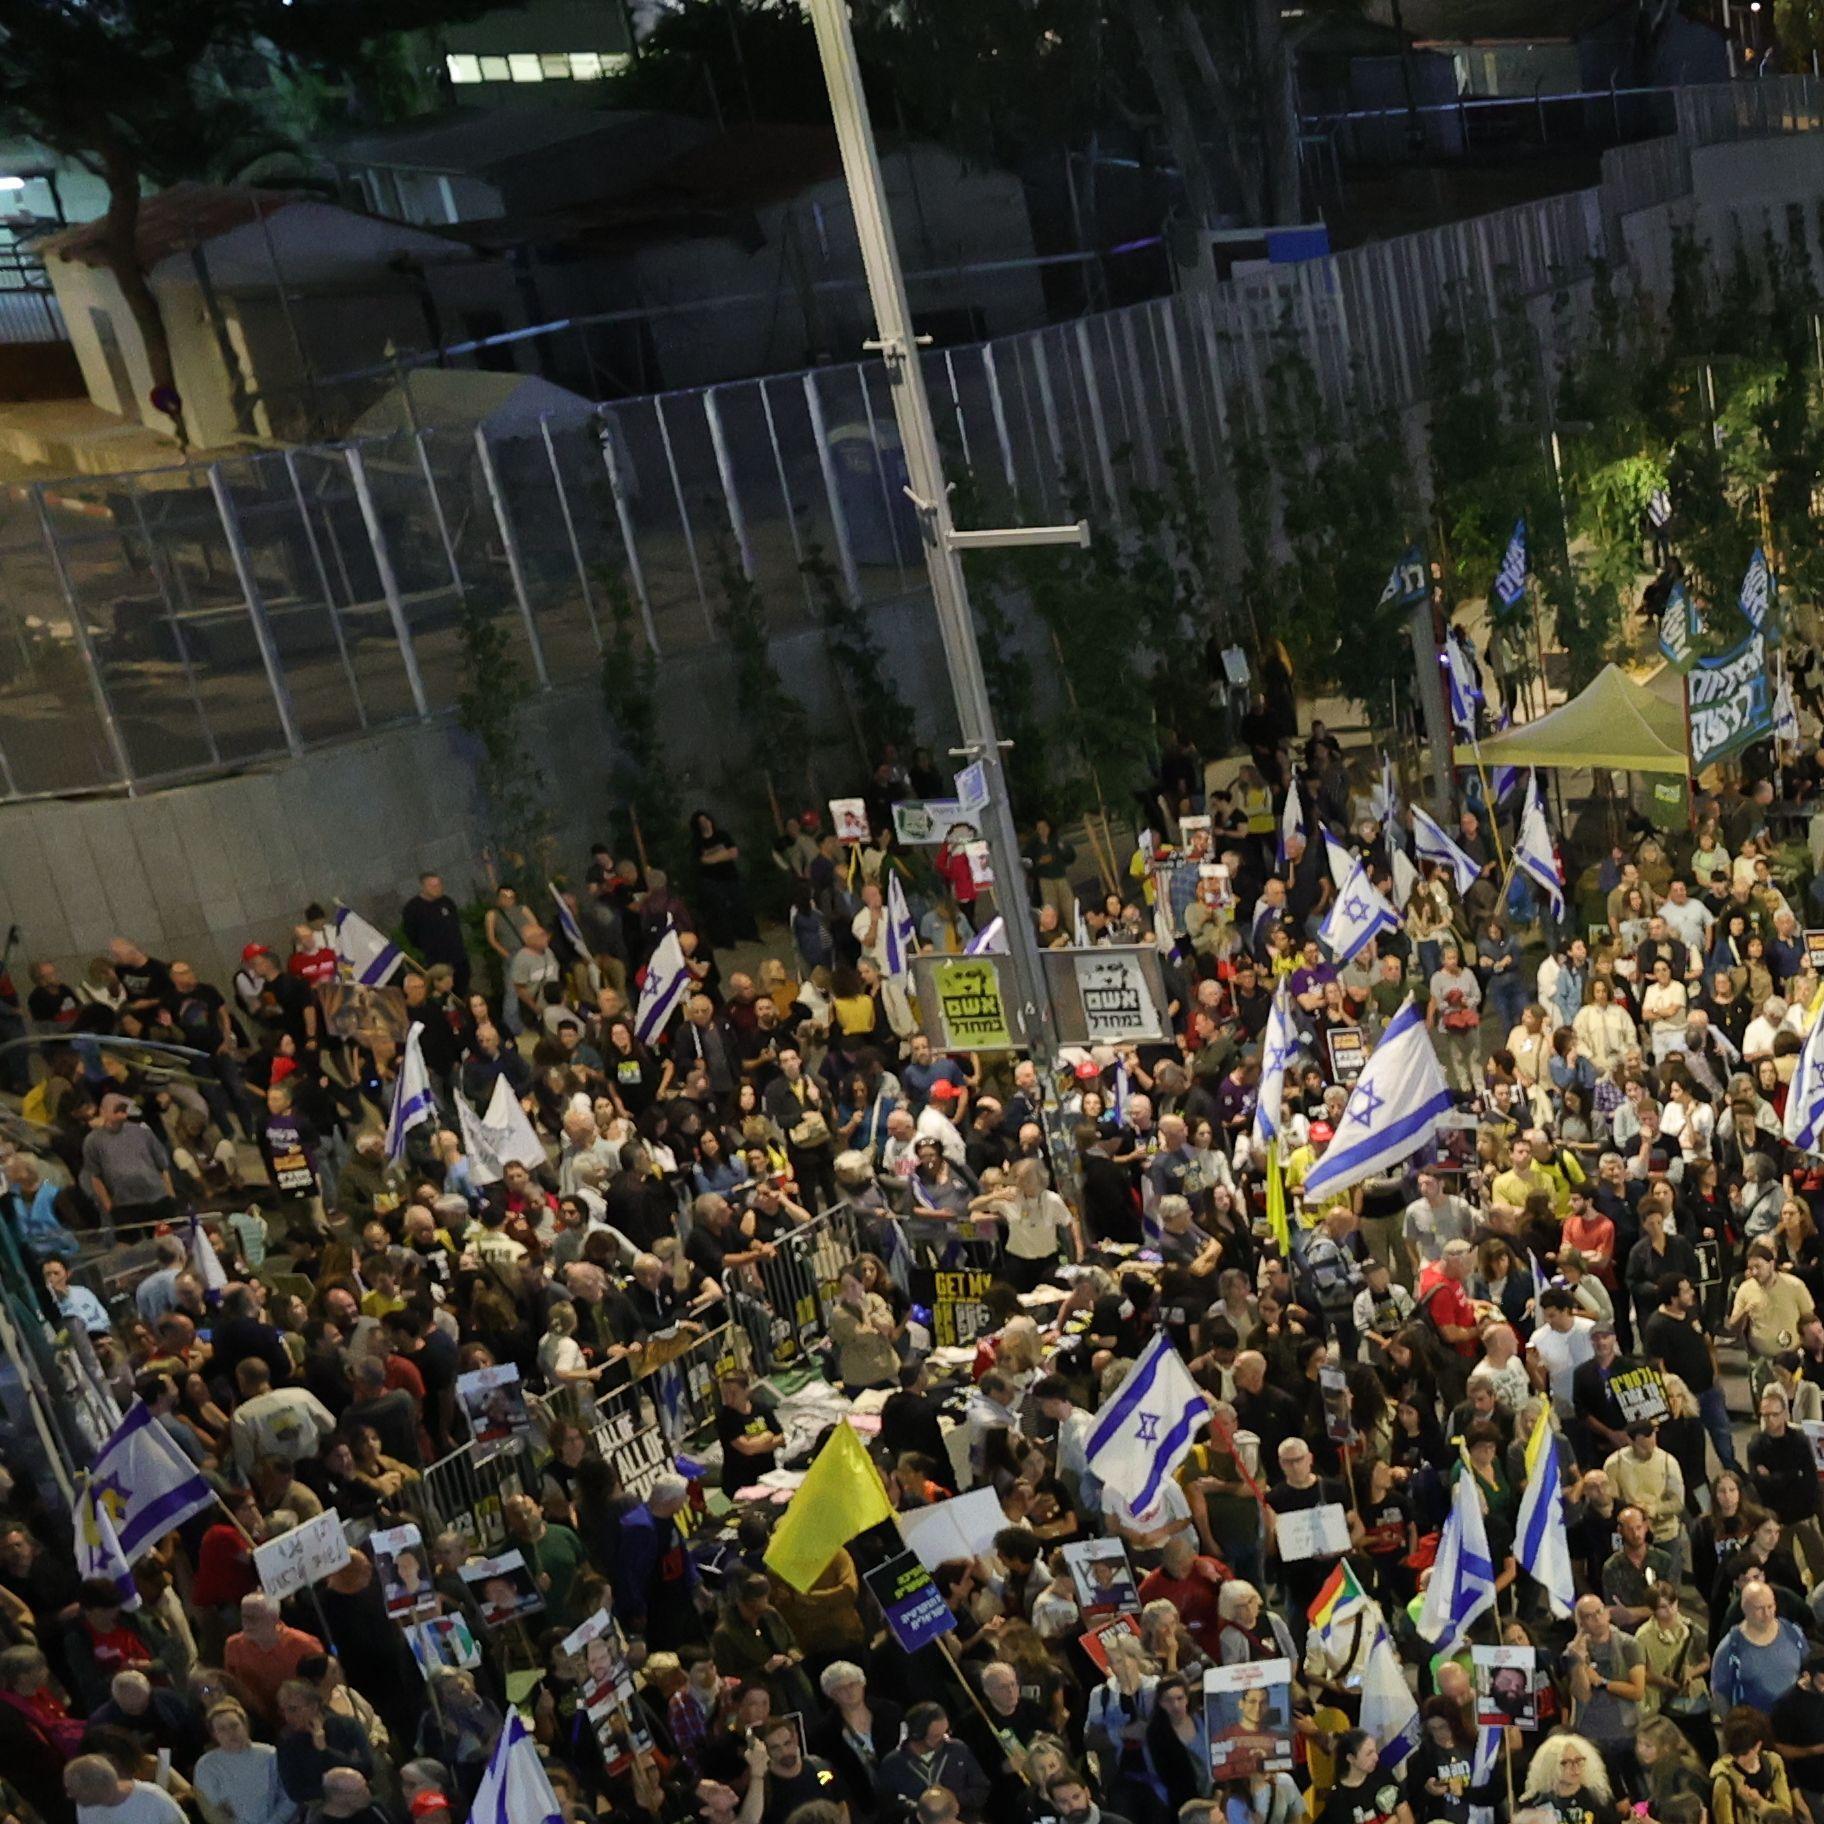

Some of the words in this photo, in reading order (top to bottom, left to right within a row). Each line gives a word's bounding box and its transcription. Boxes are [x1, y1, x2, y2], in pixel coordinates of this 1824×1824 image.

[947, 997, 1001, 1019] אשם
[1085, 990, 1138, 1011] אשם
[949, 1018, 1005, 1038] במחדל
[1089, 1012, 1143, 1031] במחדל
[615, 1440, 652, 1488] ALL
